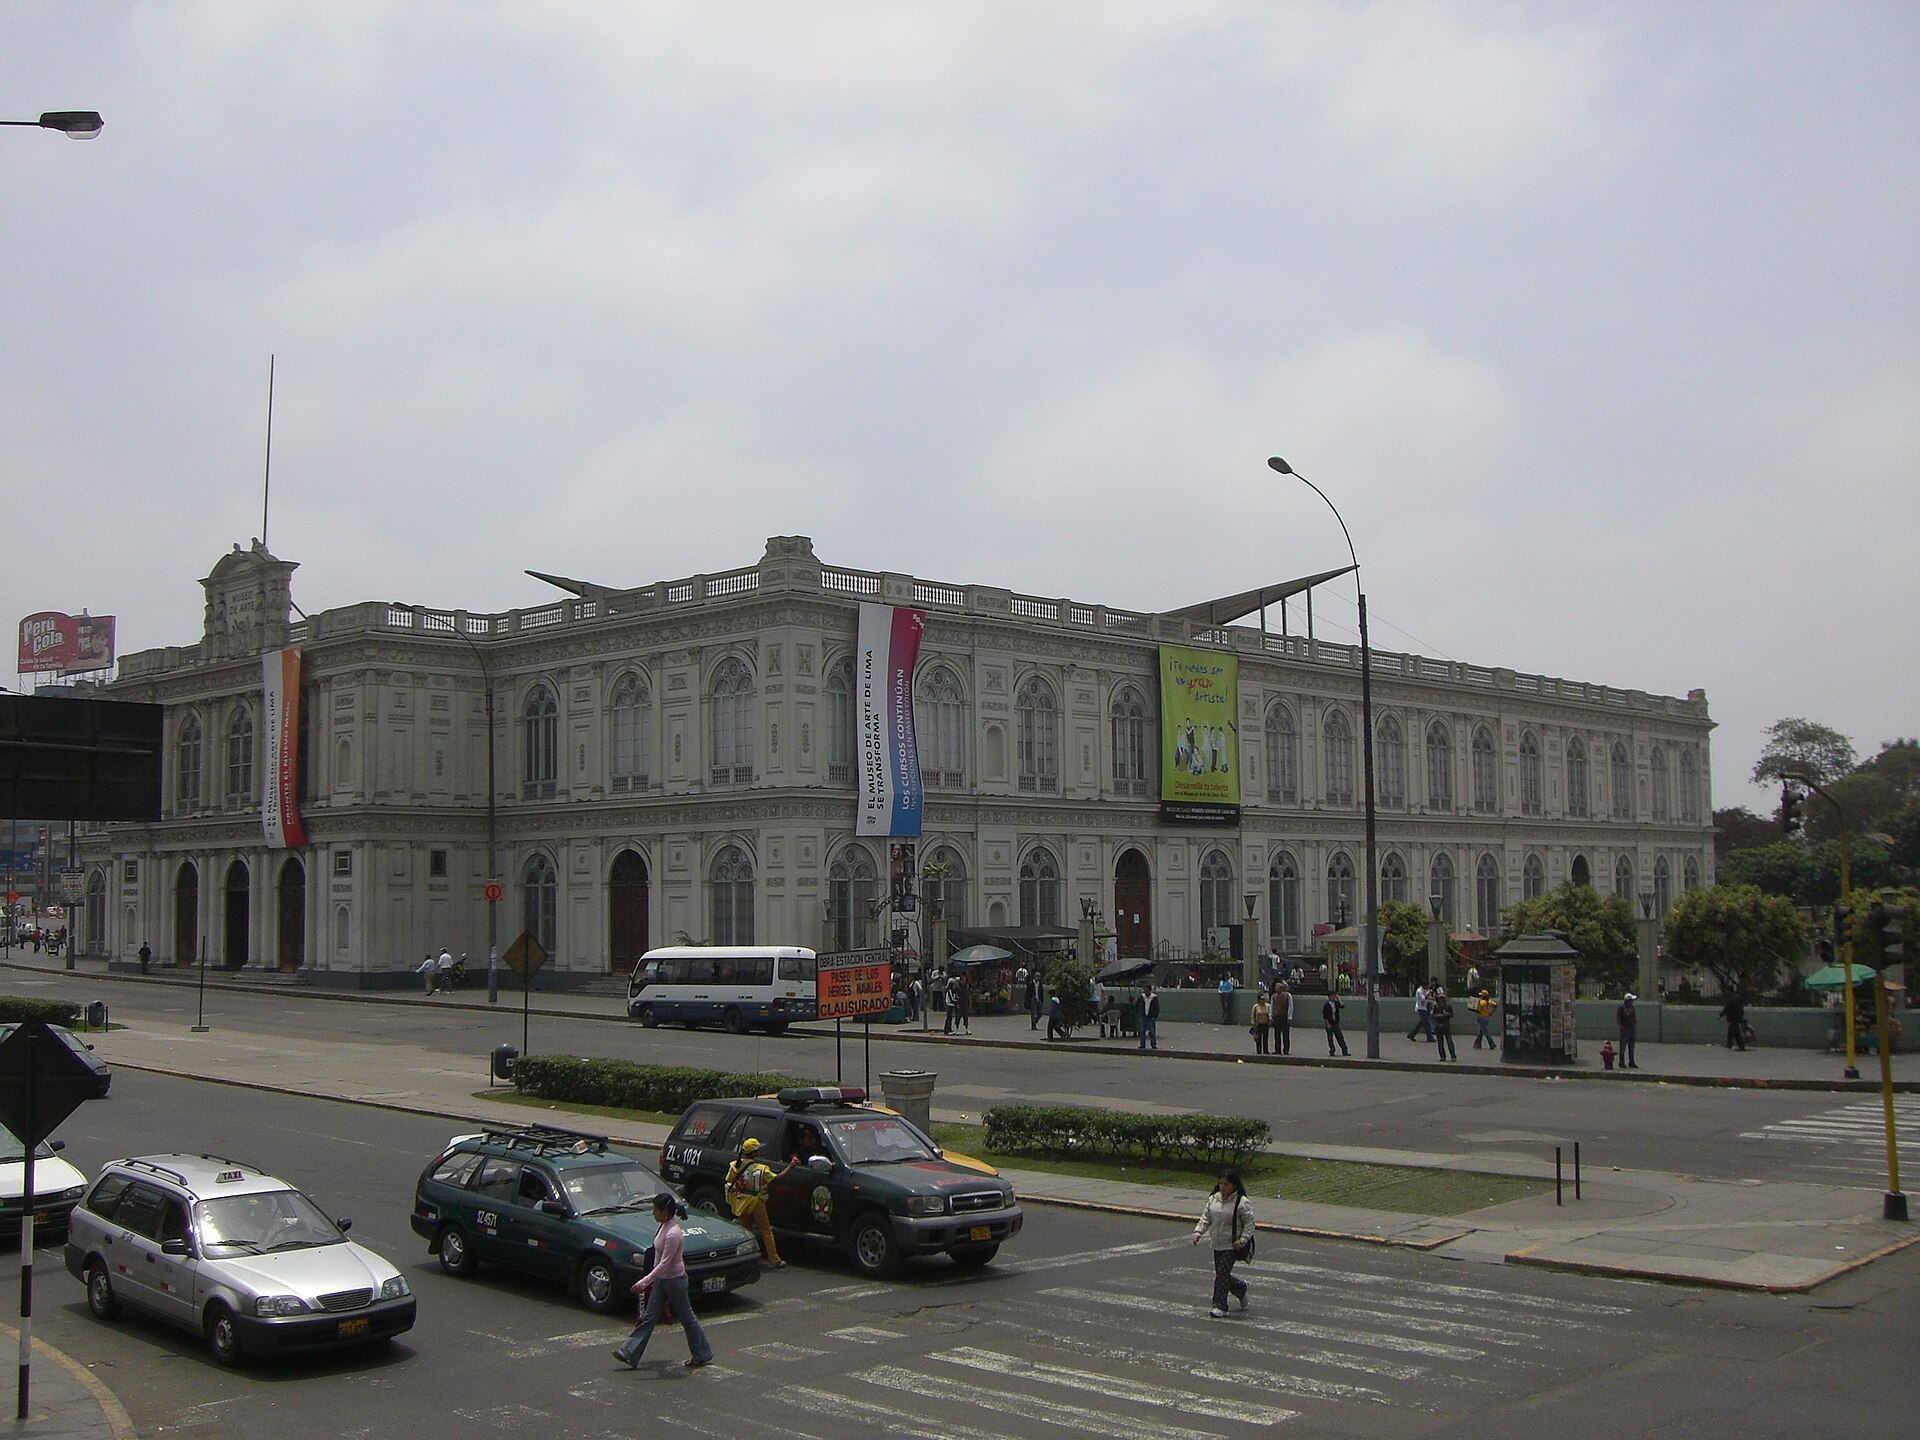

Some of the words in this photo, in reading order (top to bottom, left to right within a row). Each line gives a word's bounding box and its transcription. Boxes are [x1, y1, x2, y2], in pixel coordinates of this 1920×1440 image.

[232, 591, 253, 603] MUSEO
[230, 605, 238, 615] DE
[239, 601, 254, 612] ARTE
[24, 617, 55, 645] Perú
[33, 631, 64, 655] Cola
[1210, 666, 1223, 675] ser
[864, 683, 871, 697] DE
[1187, 678, 1213, 695] gran
[895, 669, 905, 739] CONTINÚAN
[270, 719, 275, 732] DE
[904, 709, 912, 735] PASEO
[865, 733, 872, 748] DE
[906, 736, 912, 748] EN
[873, 713, 884, 794] TRANSFORMA
[270, 762, 275, 775] DE
[899, 742, 909, 787] CURSOS
[283, 771, 288, 780] EL
[866, 751, 875, 794] MUSEO
[907, 749, 917, 810] INSCRIPCIONES
[868, 797, 875, 809] EL
[877, 797, 884, 810] SE
[902, 789, 910, 810] LOS
[267, 816, 273, 826] EL
[837, 955, 864, 966] ESTACION
[865, 952, 889, 963] CENTRAL
[831, 971, 850, 983] PASEO
[855, 969, 863, 981] DE
[867, 968, 878, 980] LOS
[828, 985, 851, 998] HEROES
[856, 981, 883, 994] NAVALES
[820, 997, 889, 1016] CLAUSURADO
[683, 1147, 702, 1166] 1021
[222, 1170, 242, 1180] TAXI
